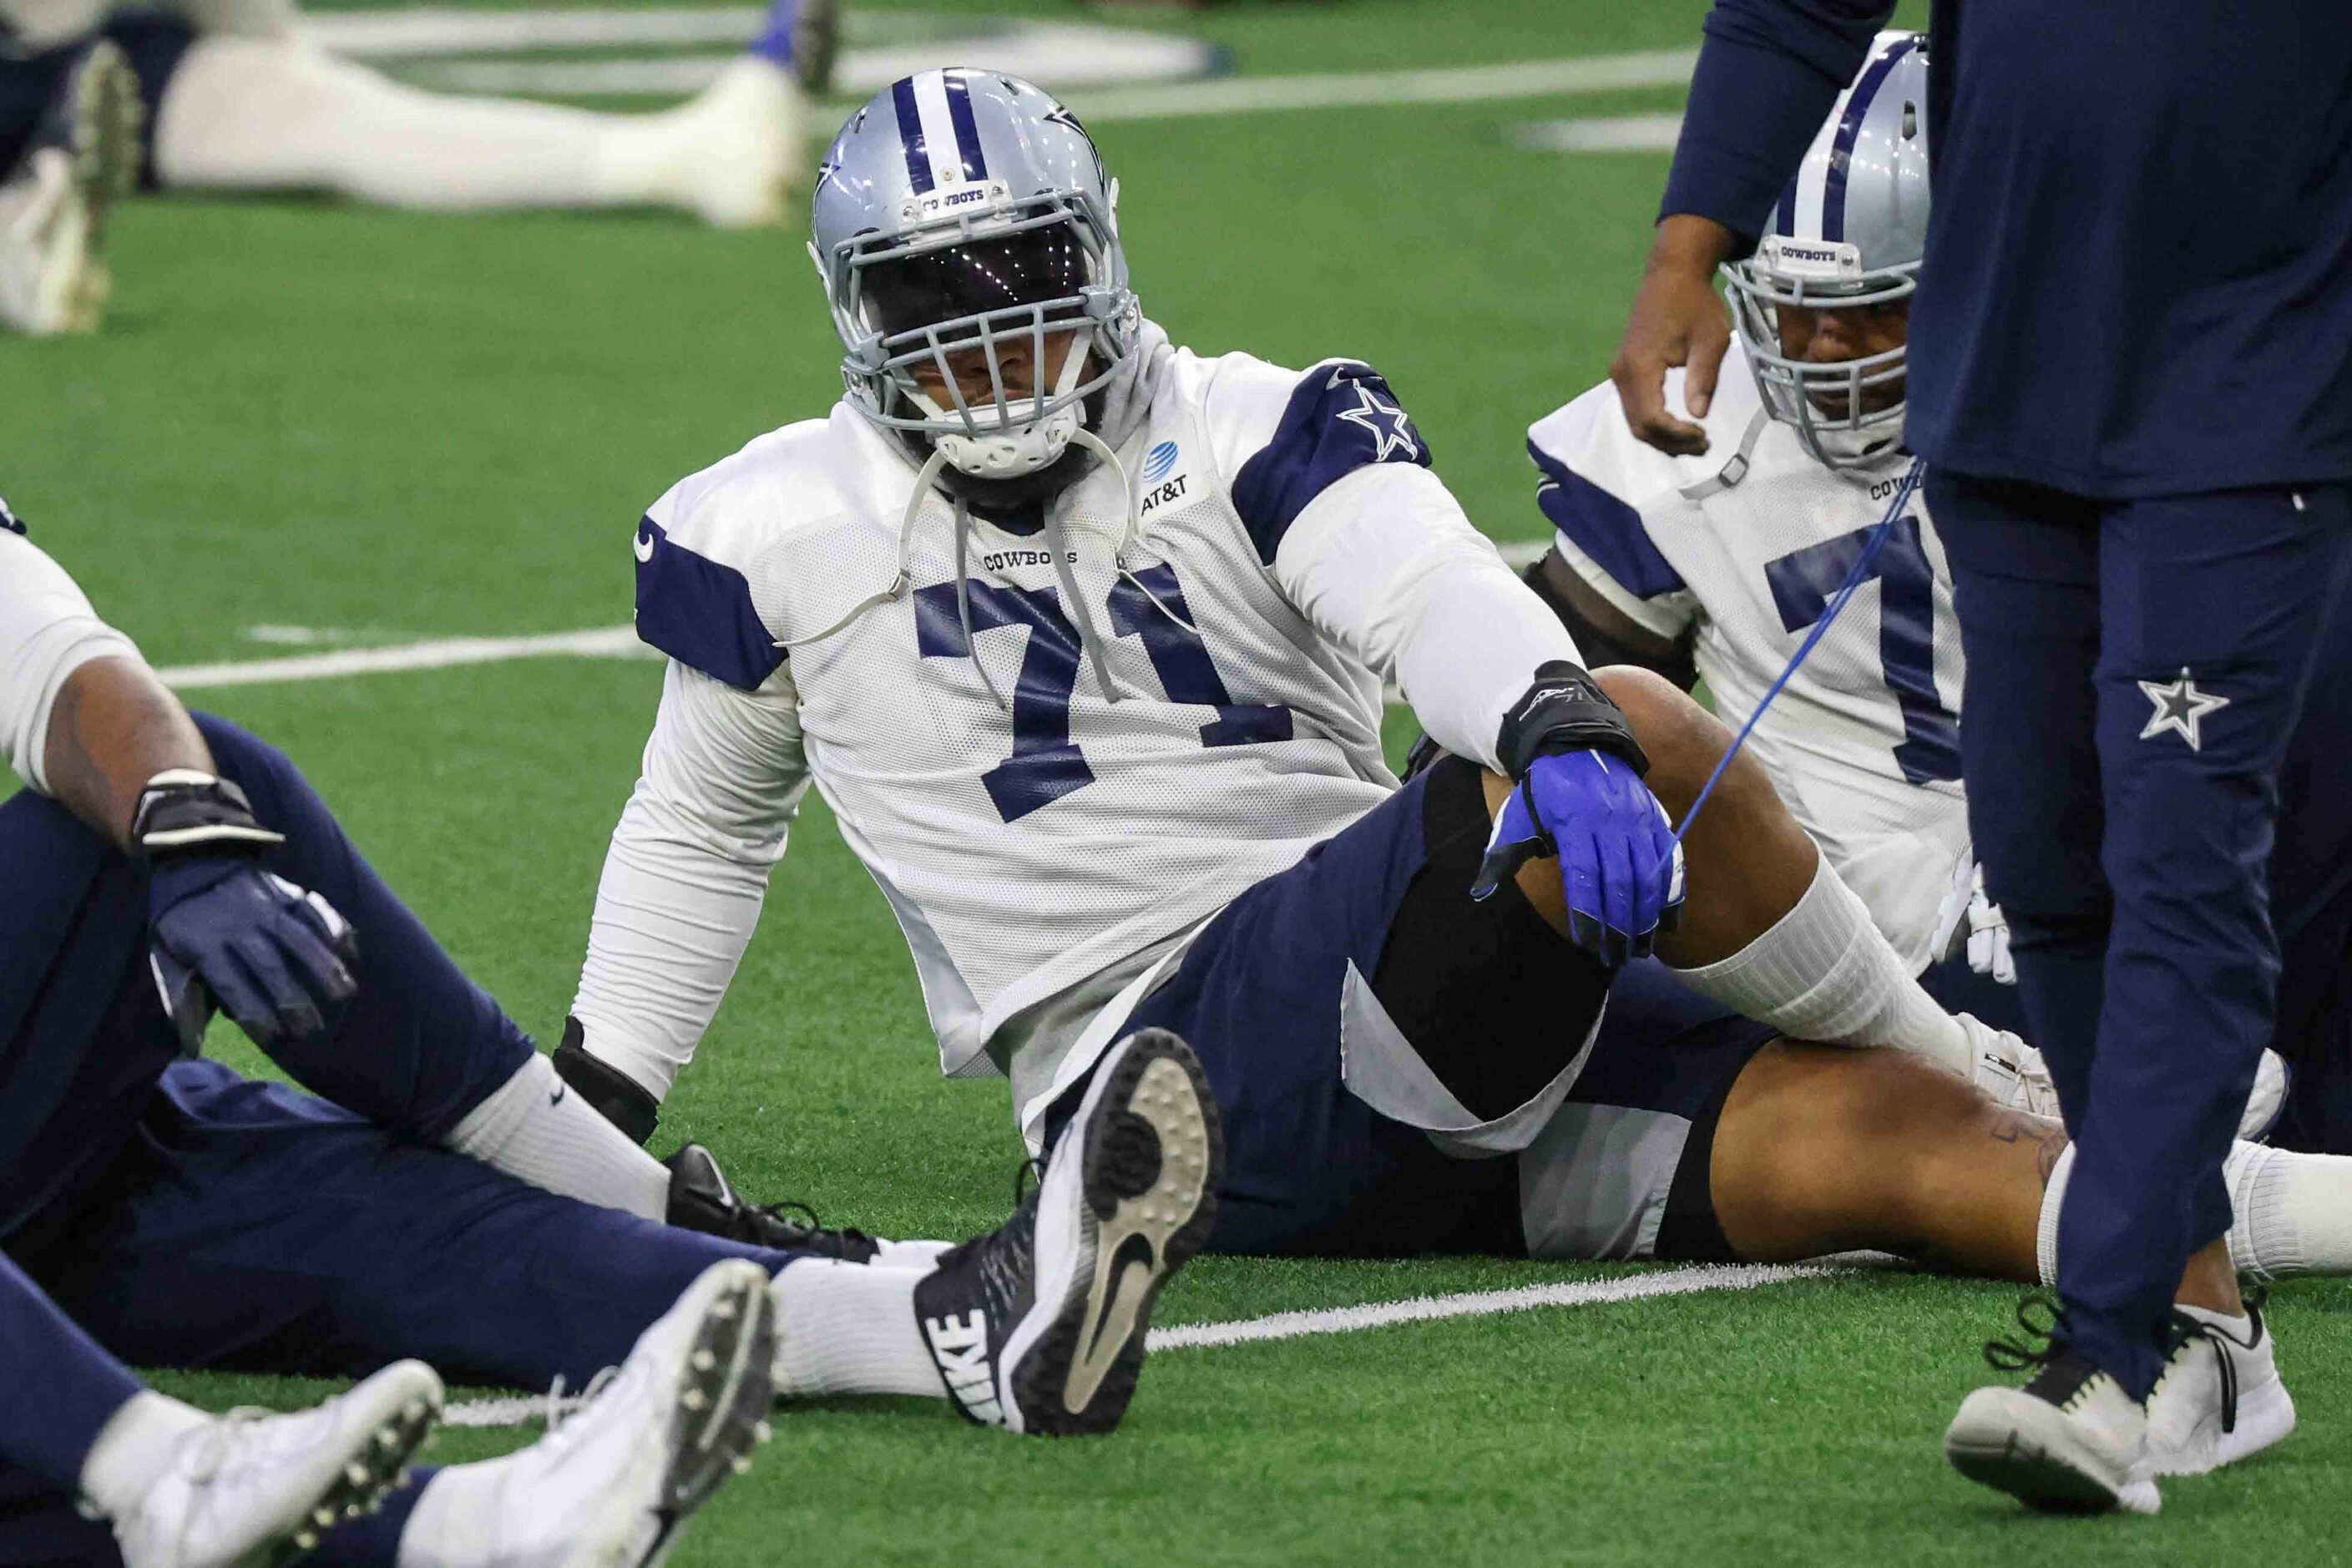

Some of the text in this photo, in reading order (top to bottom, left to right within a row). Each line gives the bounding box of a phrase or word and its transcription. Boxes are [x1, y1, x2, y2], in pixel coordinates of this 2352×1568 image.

[1781, 246, 1836, 261] COWBOYS
[1141, 473, 1186, 517] AT&T
[984, 551, 1077, 571] COWBOS
[914, 563, 1293, 824] 71
